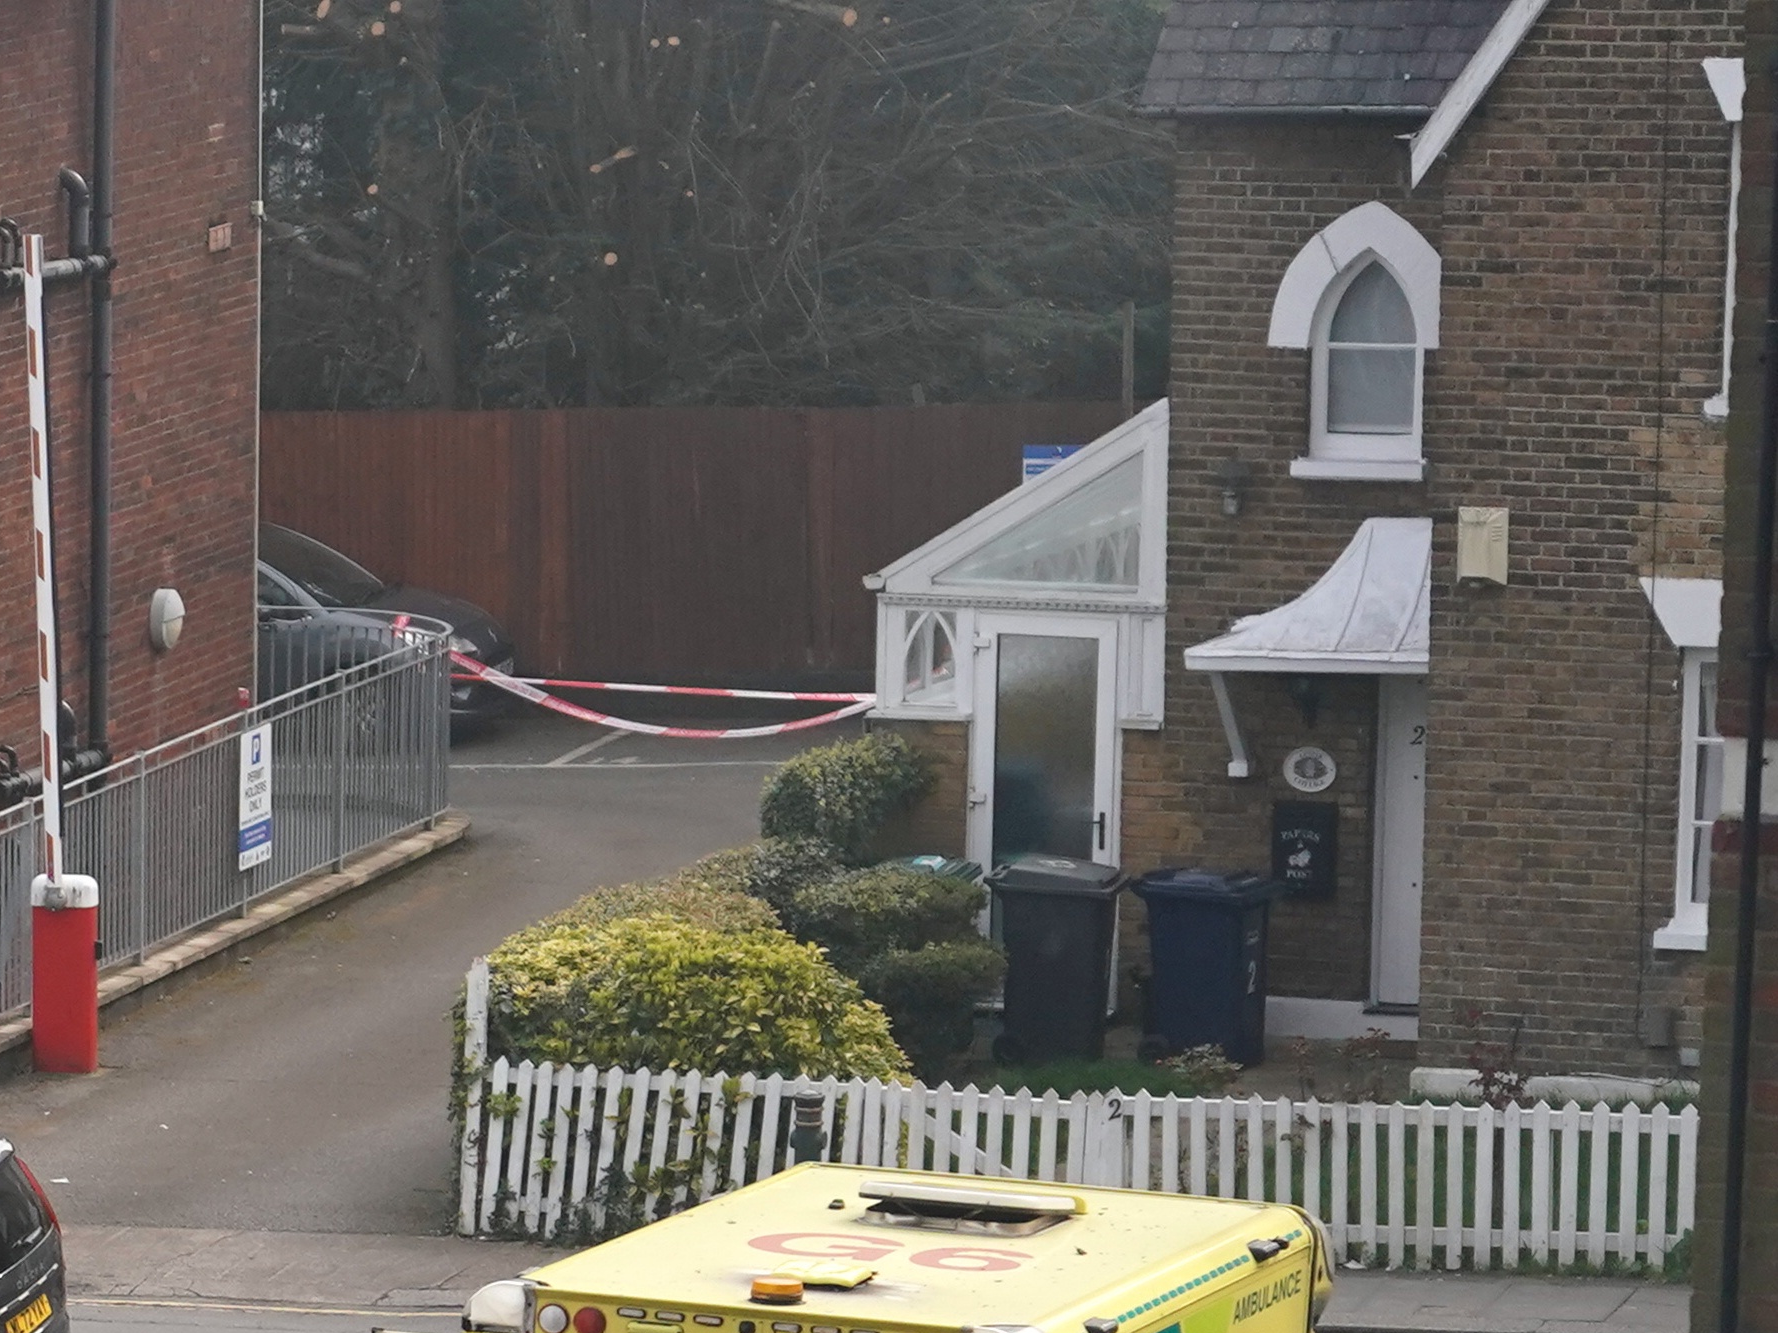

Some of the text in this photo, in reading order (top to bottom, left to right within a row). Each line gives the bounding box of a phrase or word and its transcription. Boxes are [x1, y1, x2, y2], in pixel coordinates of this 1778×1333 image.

[1410, 725, 1427, 746] 2
[1108, 1098, 1123, 1121] 2
[1232, 1269, 1302, 1325] AMBULANCE
